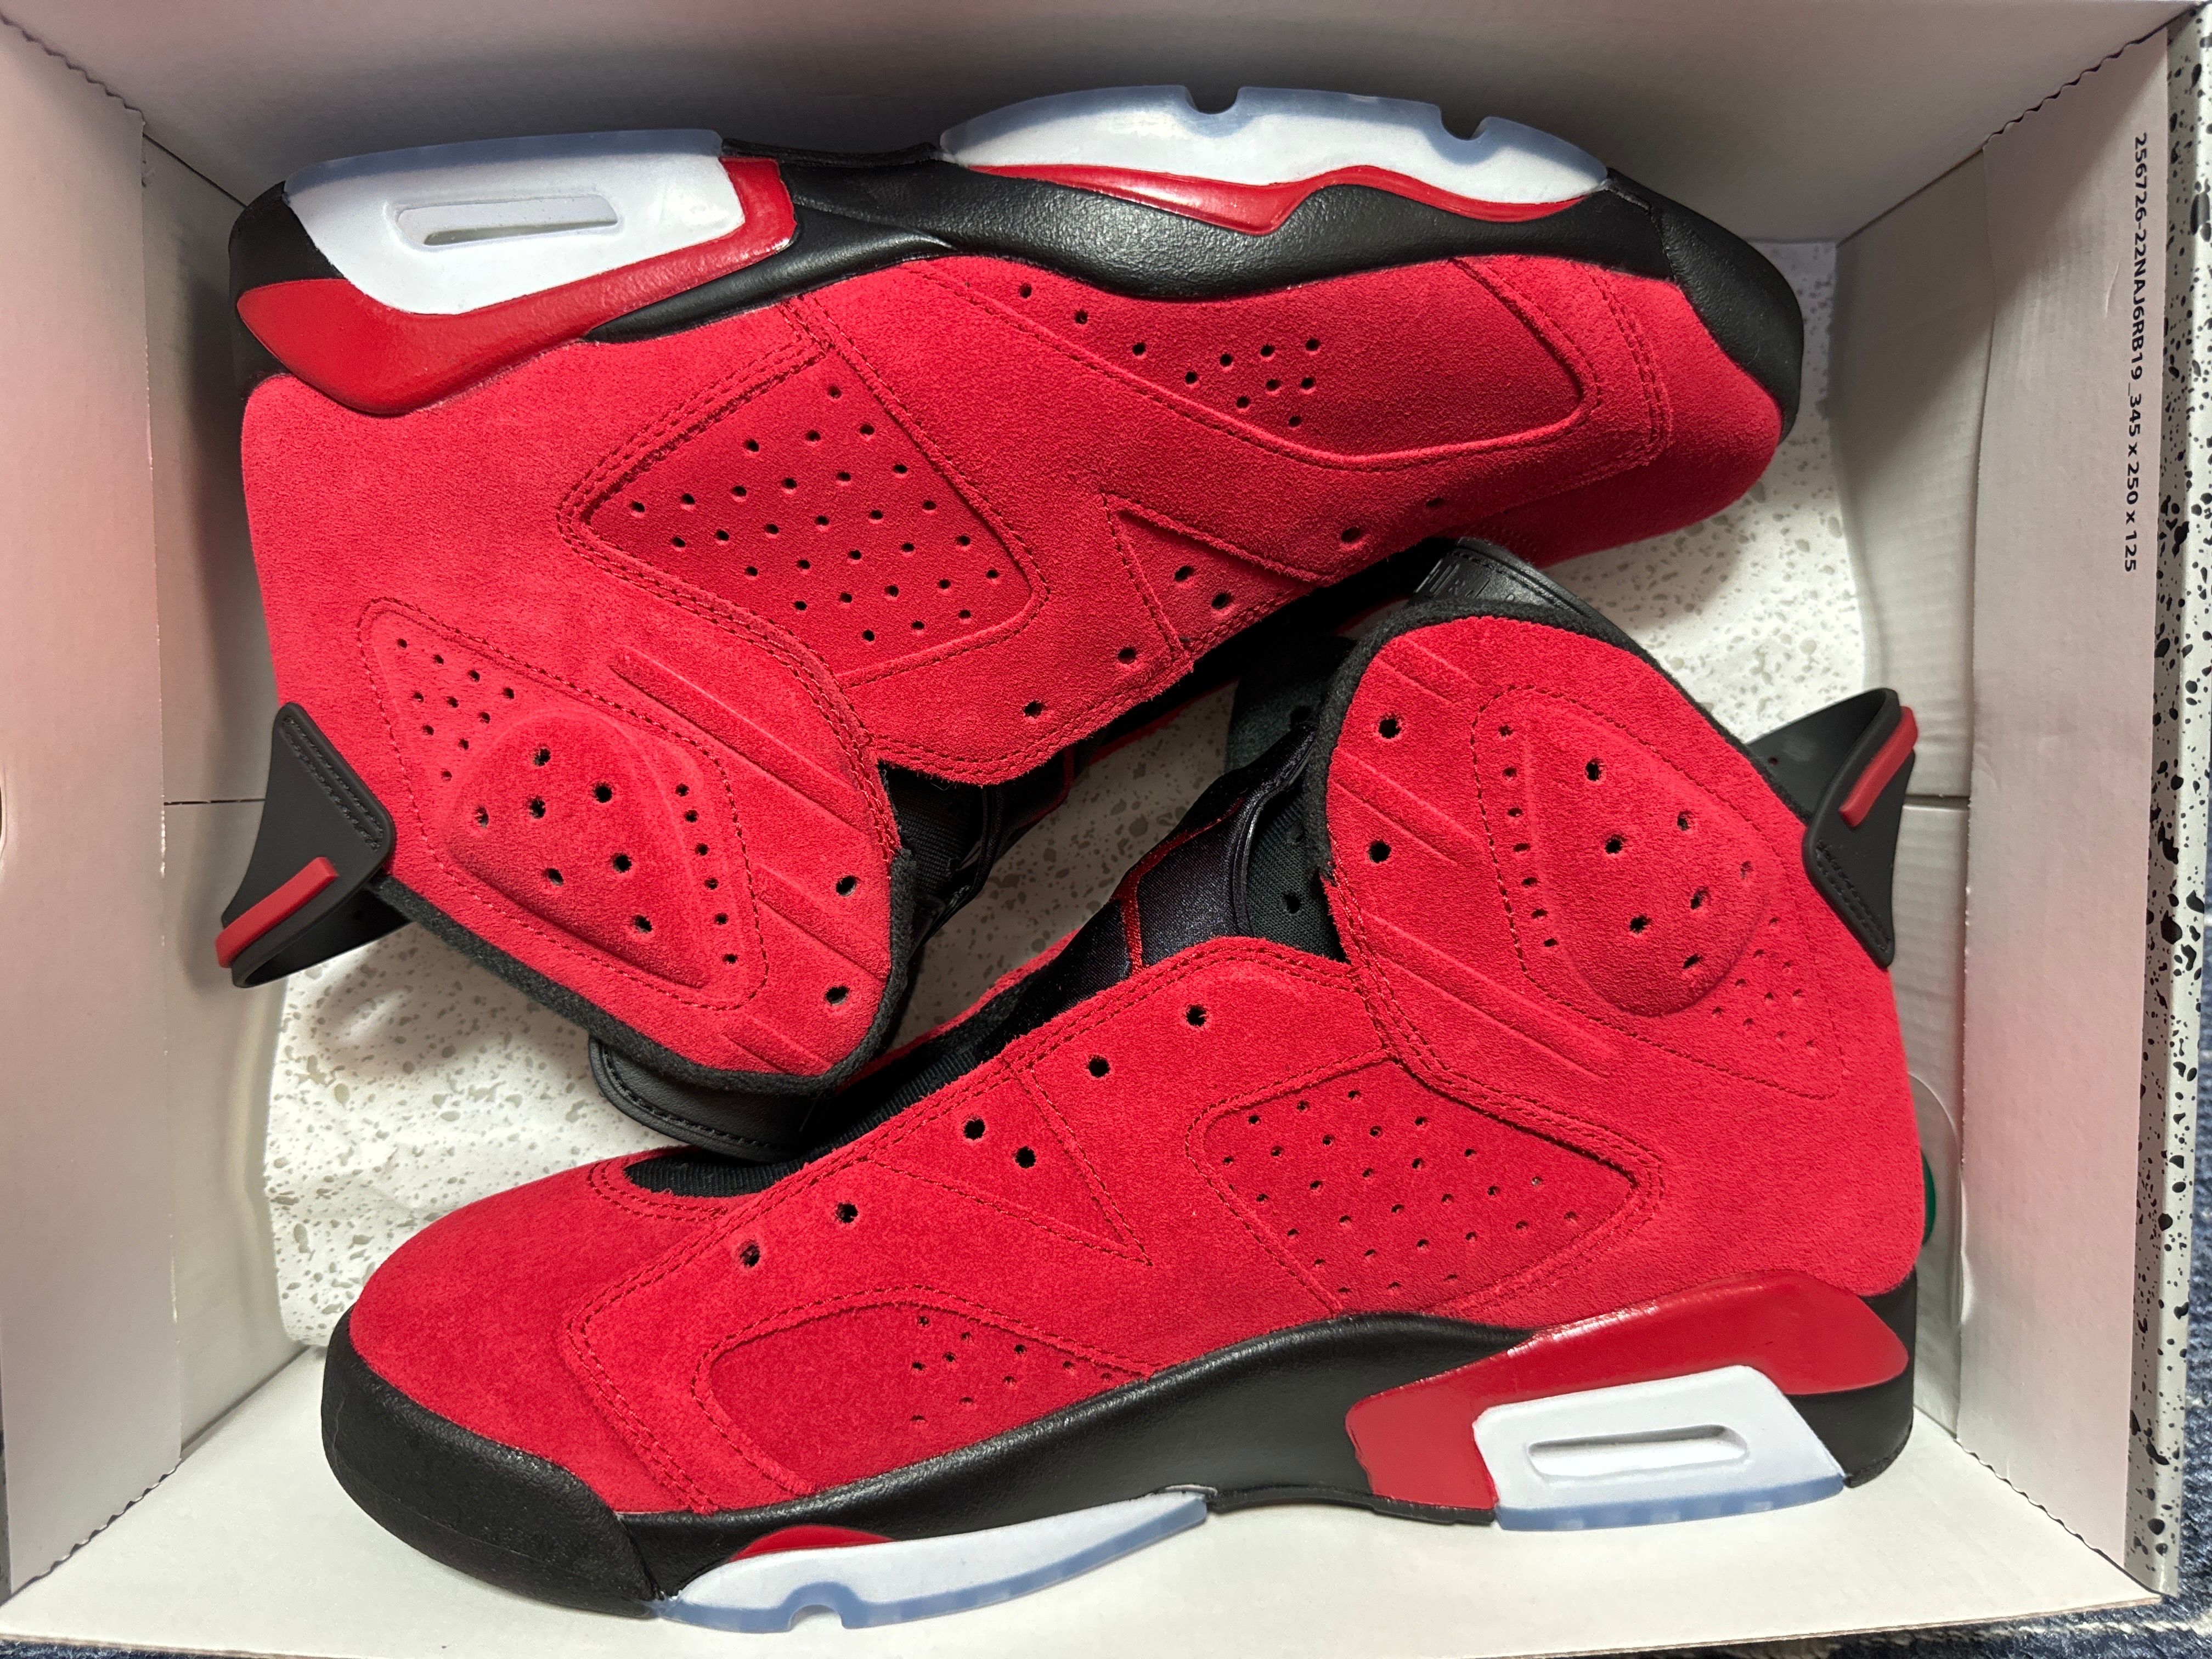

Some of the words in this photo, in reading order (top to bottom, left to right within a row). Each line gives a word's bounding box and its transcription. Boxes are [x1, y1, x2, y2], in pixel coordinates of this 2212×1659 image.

[2128, 132, 2148, 437] 256726-22NAJ6RB19_345
[2128, 442, 2138, 458] x
[2126, 460, 2140, 505] 250
[2125, 510, 2136, 525] x
[2124, 529, 2137, 572] 125
